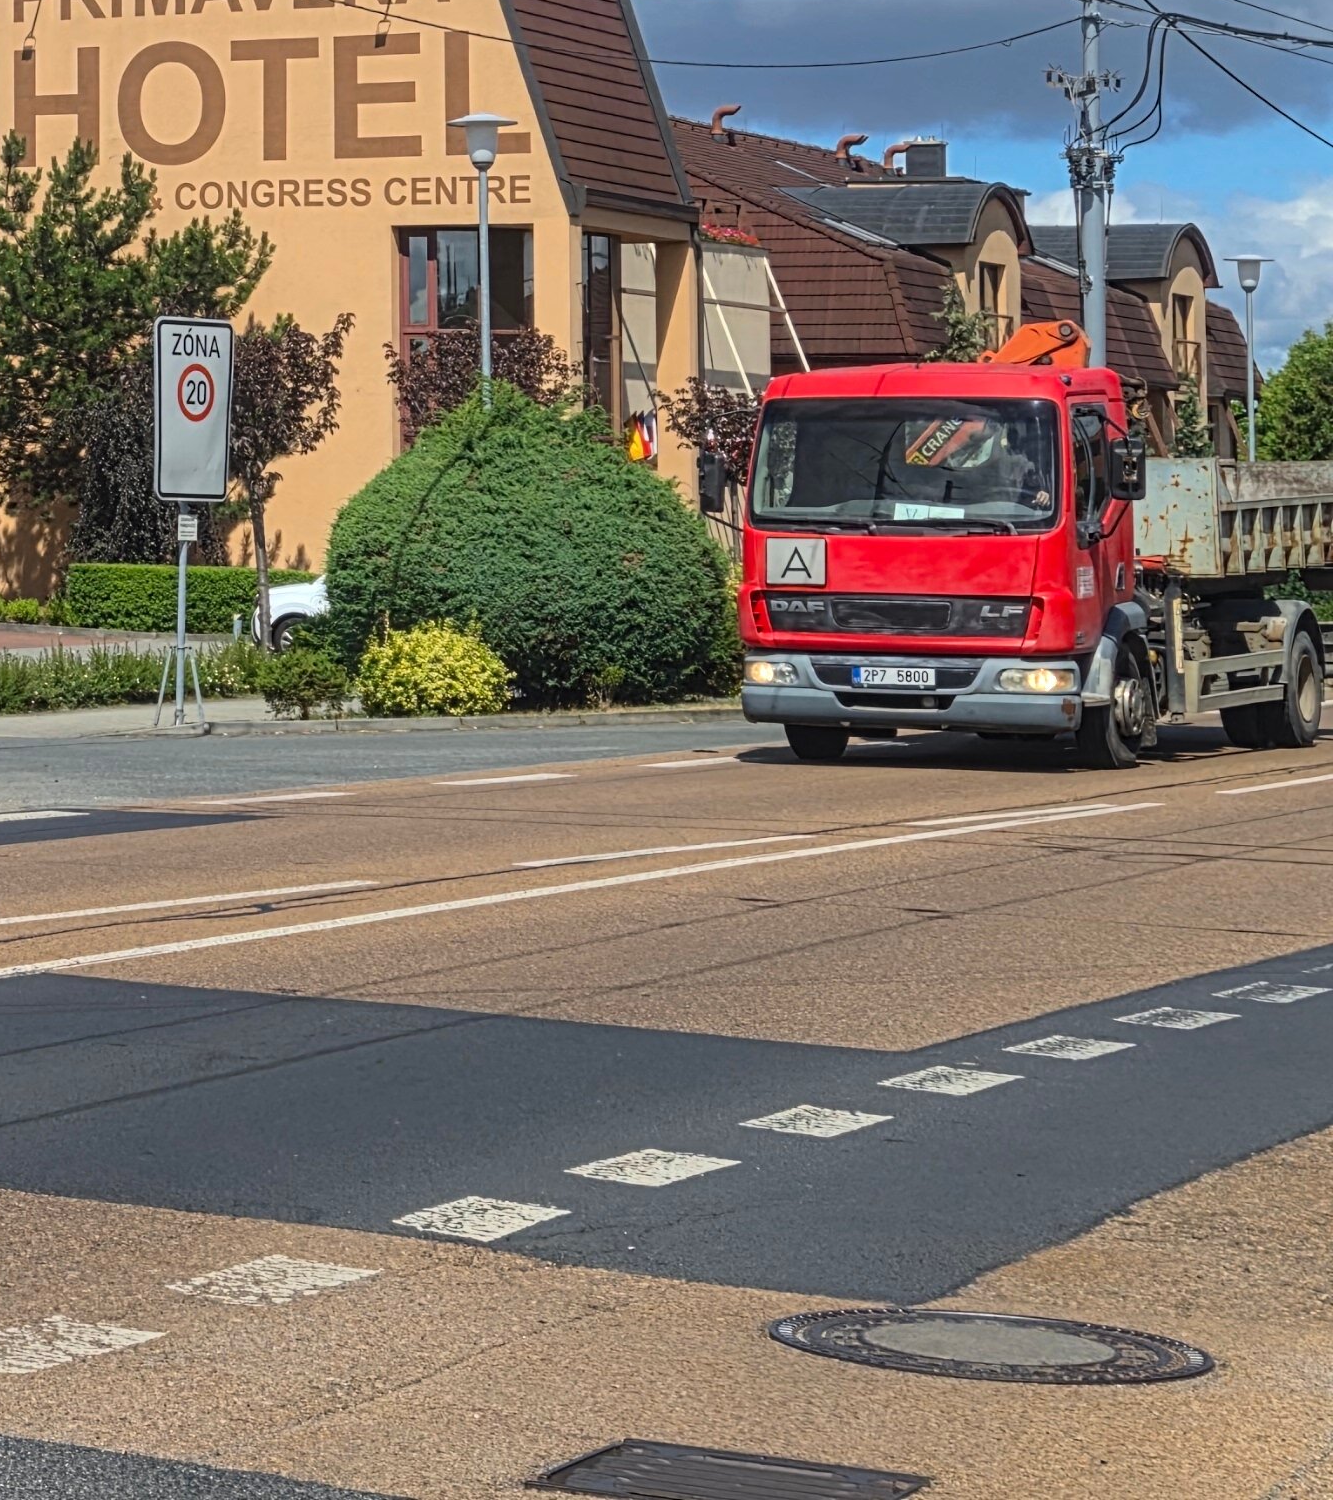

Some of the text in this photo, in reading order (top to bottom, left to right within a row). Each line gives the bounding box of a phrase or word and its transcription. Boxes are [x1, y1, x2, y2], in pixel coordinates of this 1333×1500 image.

[13, 31, 531, 167] HOTEL
[175, 177, 372, 210] CONGRESS
[384, 175, 531, 206] CENTRE
[172, 328, 221, 359] ZÓNA
[186, 379, 207, 405] 20
[781, 546, 812, 579] A
[770, 600, 825, 613] DAF
[980, 605, 1025, 618] LF
[864, 669, 887, 682] 2P7
[897, 670, 929, 683] 5800
